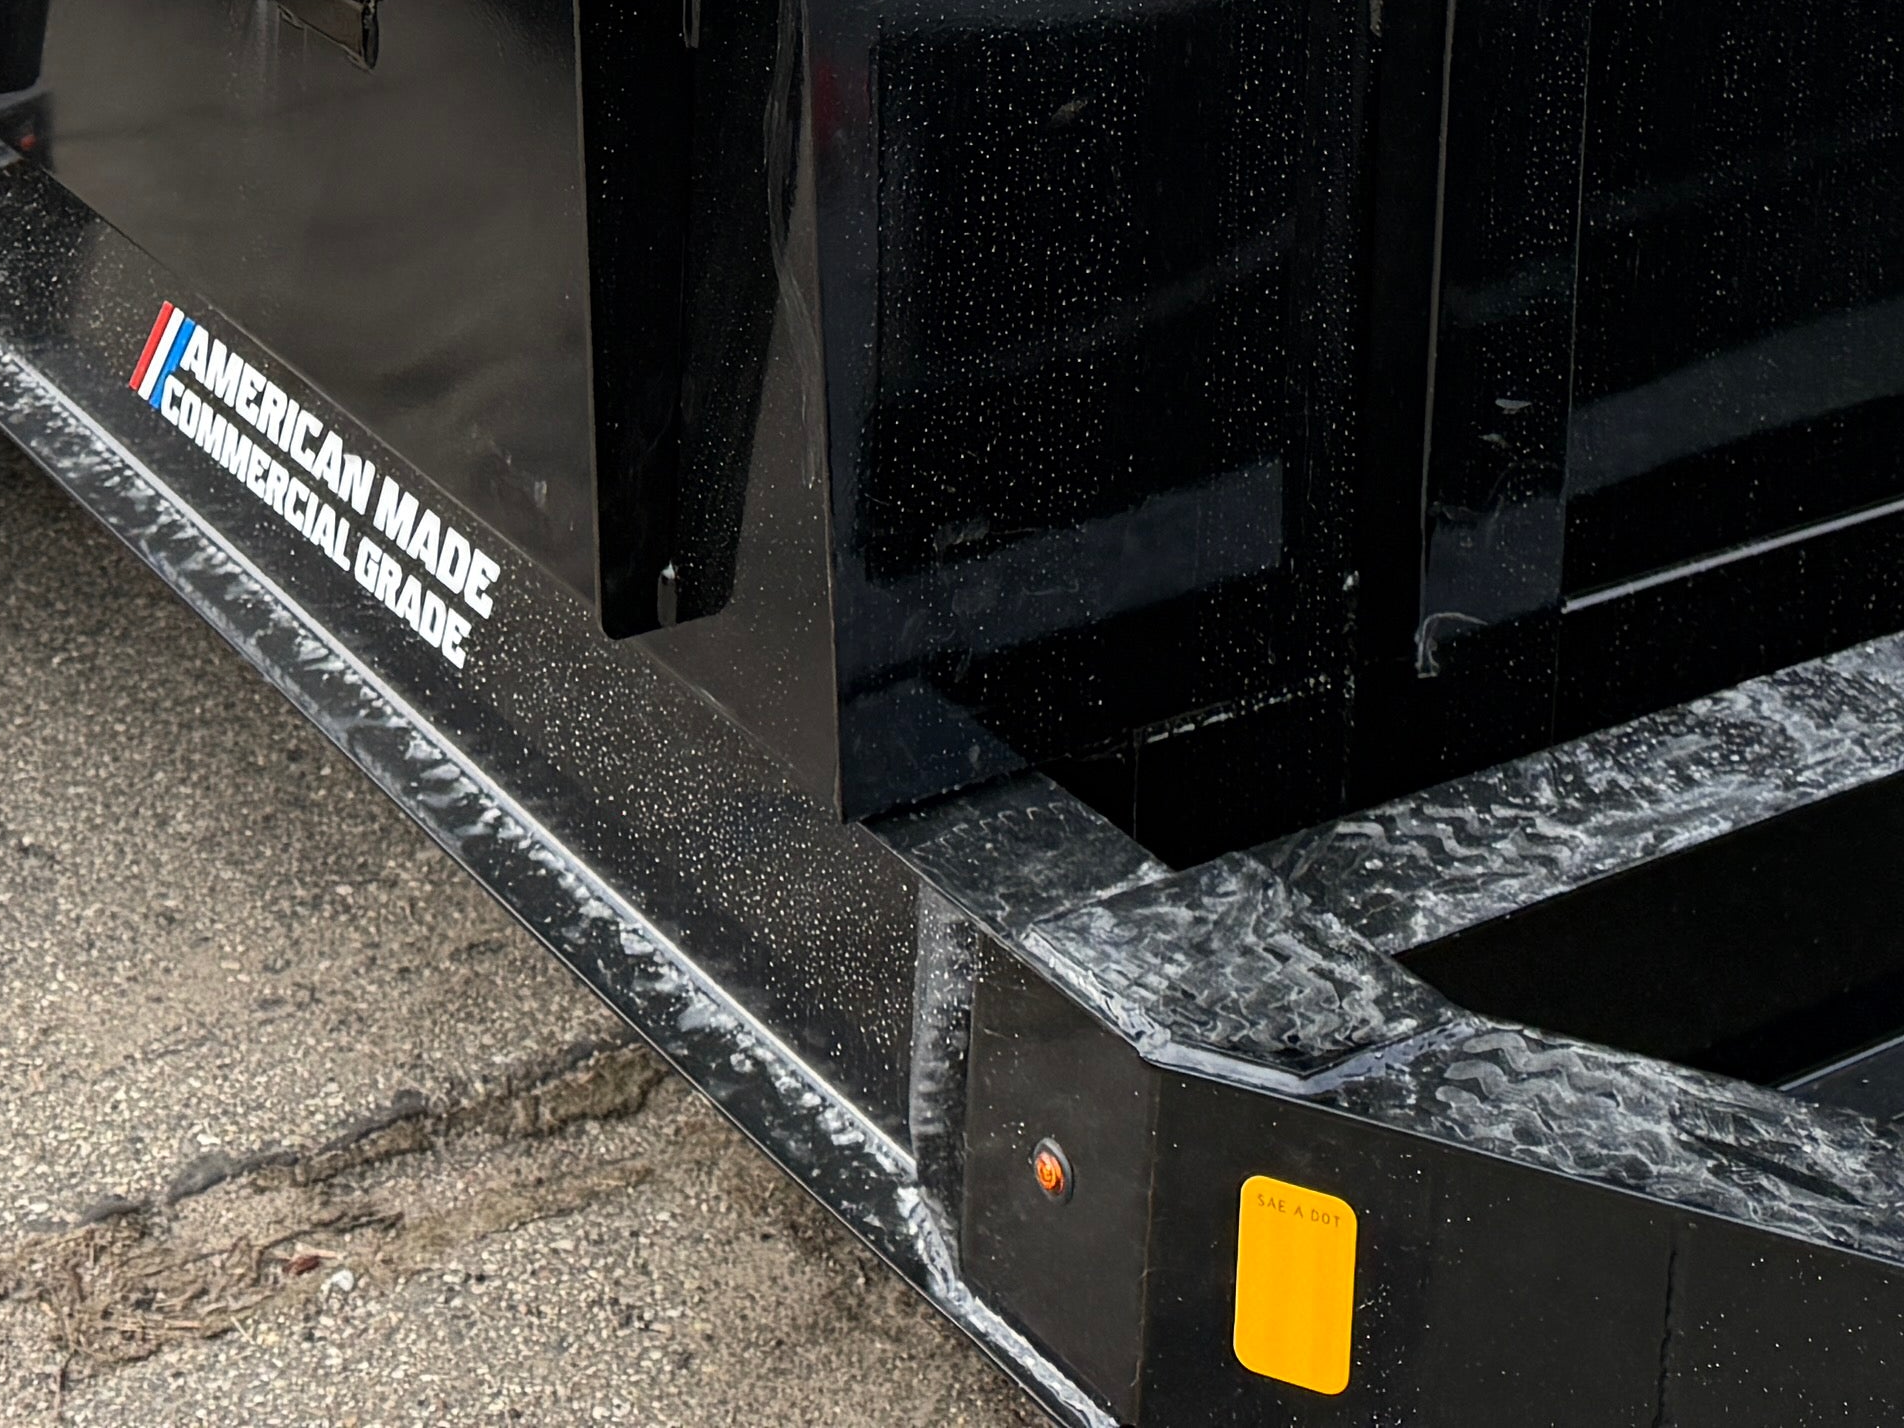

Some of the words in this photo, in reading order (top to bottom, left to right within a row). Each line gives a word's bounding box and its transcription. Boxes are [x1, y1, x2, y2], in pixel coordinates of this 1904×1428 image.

[160, 373, 351, 572] COMMERCIAL
[354, 536, 472, 669] GRADE
[179, 324, 376, 515] AMERICAN
[372, 475, 501, 620] MADE
[1257, 1193, 1287, 1213] SAE
[1294, 1205, 1304, 1219] A
[1311, 1208, 1340, 1228] DOT
